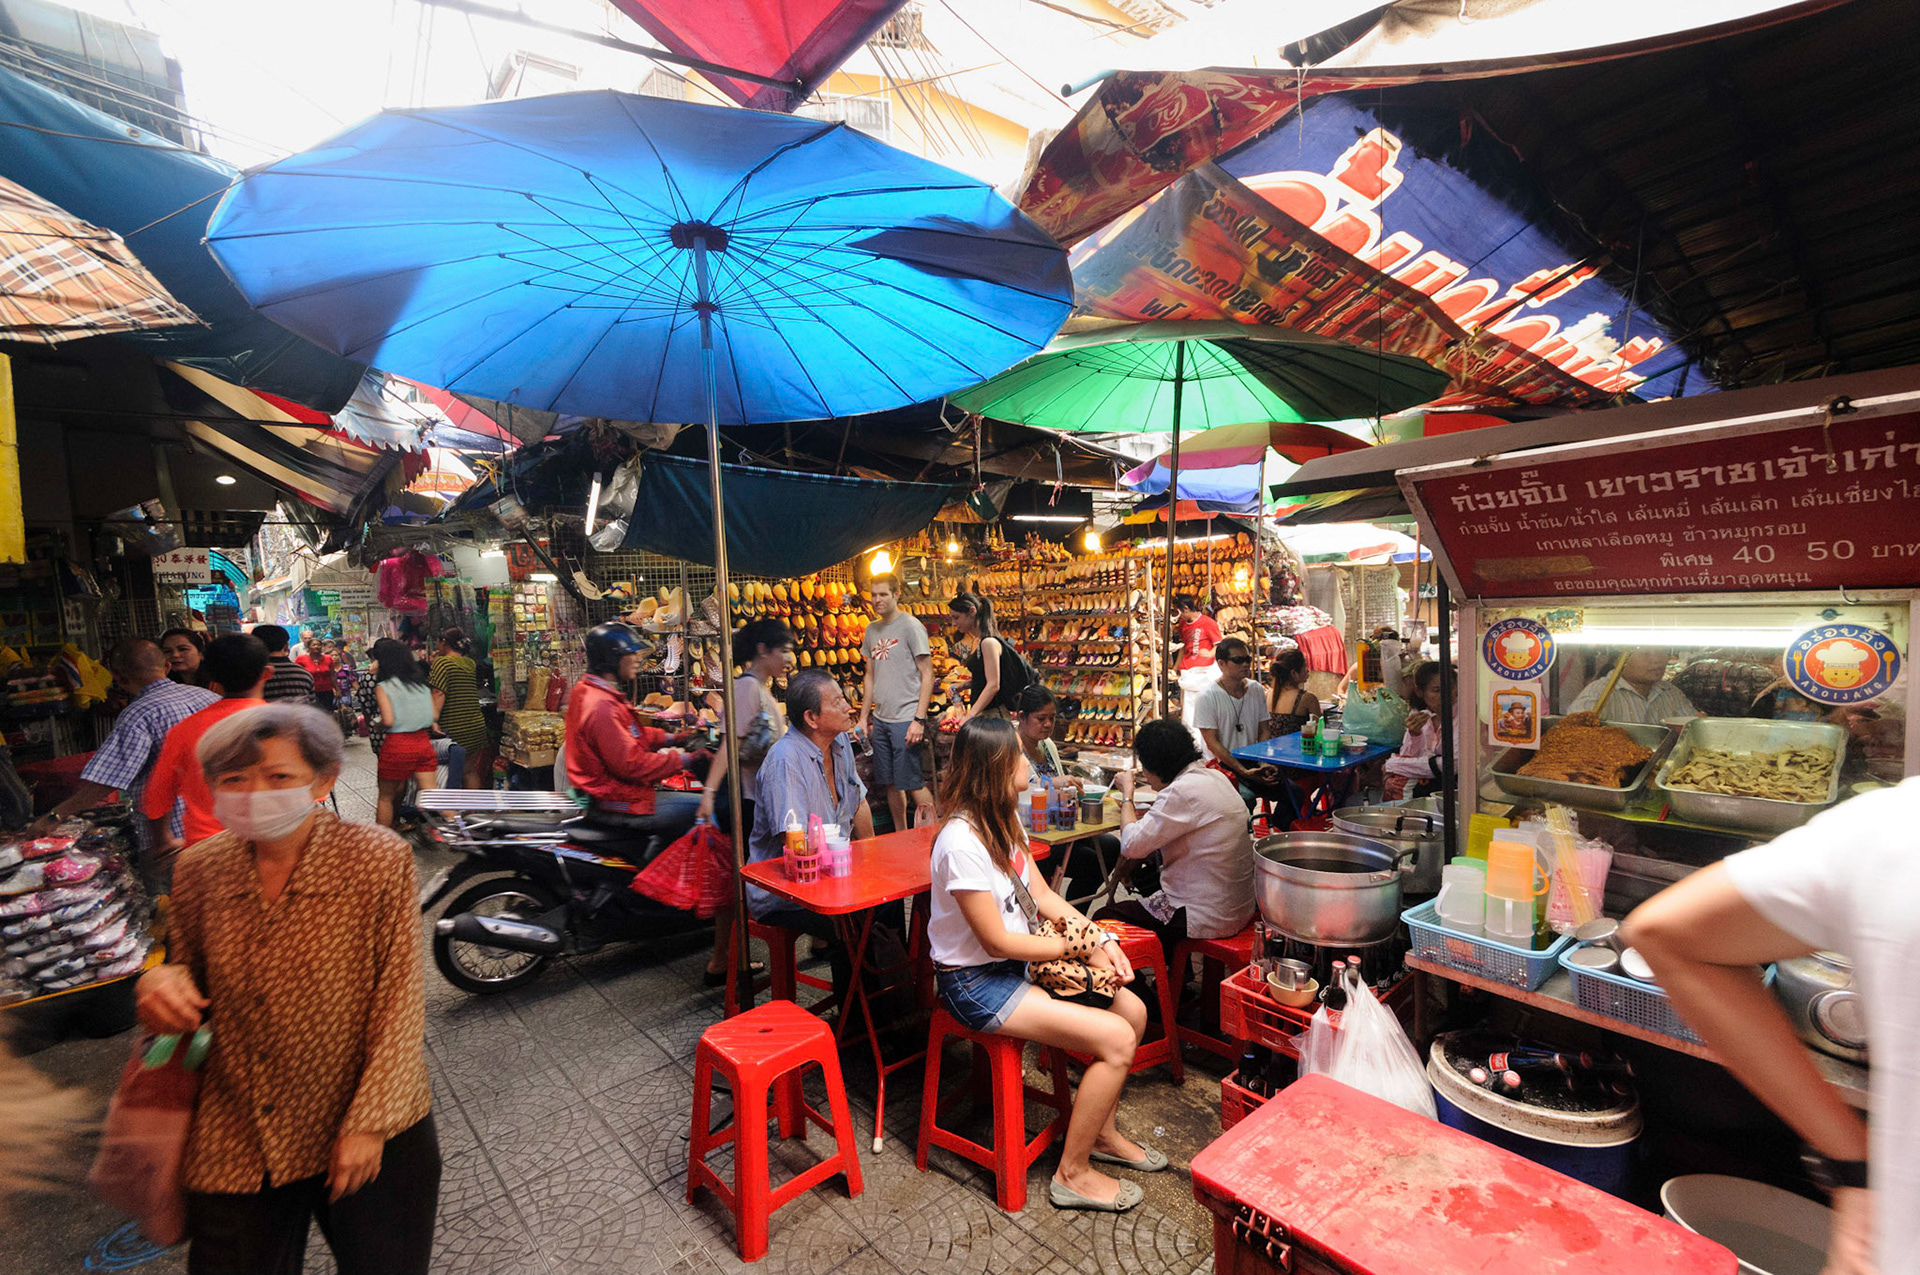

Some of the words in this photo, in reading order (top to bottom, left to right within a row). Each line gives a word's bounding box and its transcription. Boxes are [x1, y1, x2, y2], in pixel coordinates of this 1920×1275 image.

[1659, 551, 1714, 568] พิเศษ
[1732, 544, 1776, 565] 40
[1806, 539, 1856, 562] 50
[1491, 662, 1544, 678] AROIJANG
[1800, 680, 1883, 700] AROIJANG
